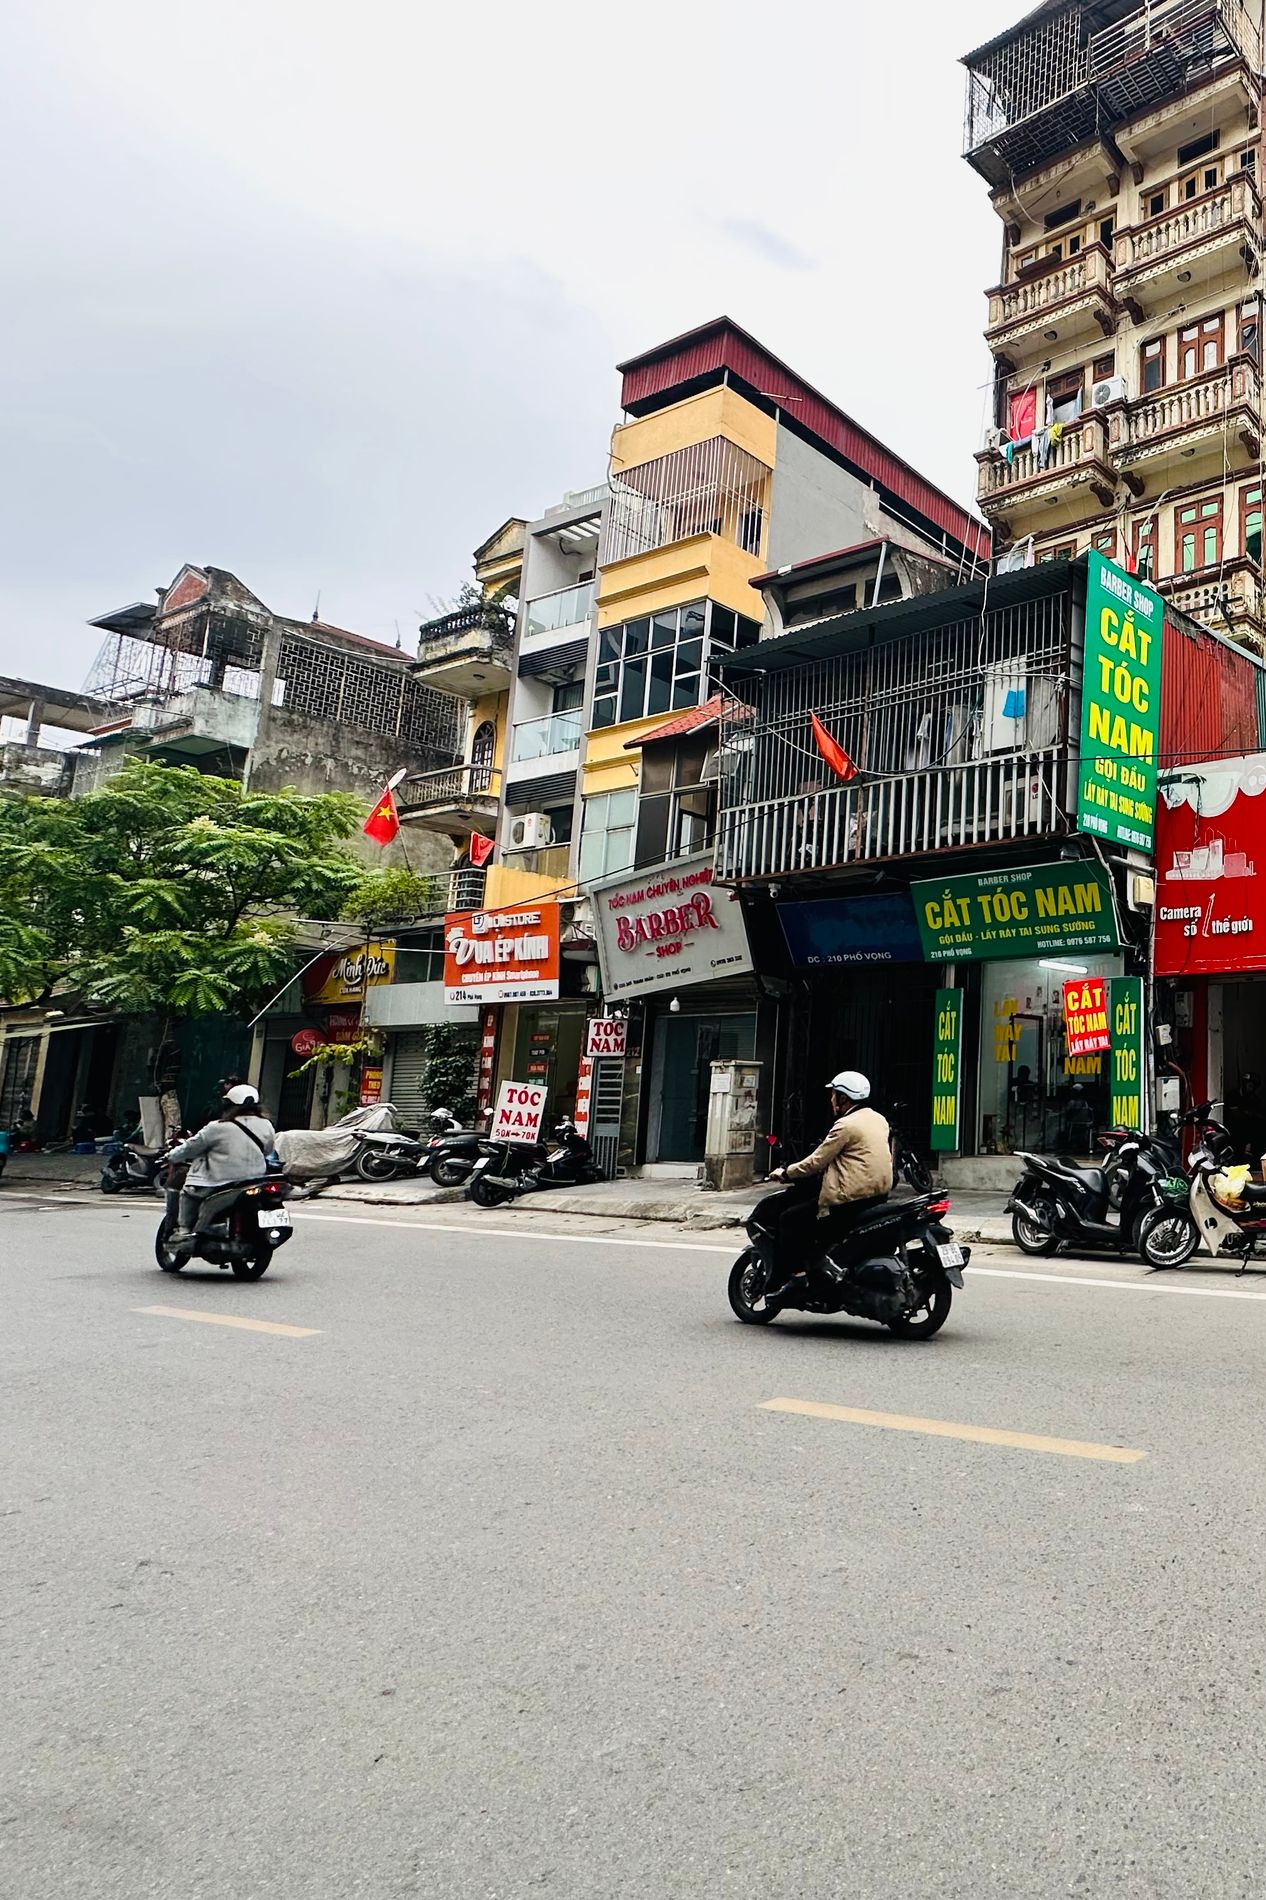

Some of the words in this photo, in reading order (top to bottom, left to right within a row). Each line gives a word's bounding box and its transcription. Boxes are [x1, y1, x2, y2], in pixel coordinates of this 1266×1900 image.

[1100, 566, 1132, 604] BARBER
[1133, 590, 1154, 617] SHOP
[1100, 607, 1152, 667] CẮT
[1098, 653, 1150, 713] TÓC
[1088, 701, 1154, 766] NAM
[977, 874, 1009, 887] BARBER
[1011, 872, 1032, 883] SHOP
[626, 888, 645, 907] NAM
[924, 888, 971, 930] CẮT
[977, 886, 1029, 924] TÓC
[1034, 881, 1102, 918] NAM
[615, 891, 719, 952] BARBER
[1159, 906, 1202, 922] Camera
[1183, 918, 1198, 938] số
[1211, 914, 1231, 935] thế
[1035, 923, 1061, 936] SUNG
[655, 941, 683, 958] SHOP
[1067, 983, 1103, 1011] CẮT
[938, 1000, 957, 1041] CẮT
[1068, 1012, 1086, 1035] TÓC
[1086, 1011, 1108, 1032] NAM
[1115, 991, 1137, 1035] CẮT
[593, 1019, 625, 1037] TÓC
[590, 1038, 626, 1053] NAM
[936, 1047, 955, 1083] TÓC
[1063, 1056, 1102, 1074] NAM
[1114, 1043, 1137, 1081] TÓC
[506, 1085, 542, 1107] TÓC
[498, 1109, 540, 1129] NAM
[933, 1096, 956, 1126] NAM
[1112, 1095, 1139, 1128] NAM
[495, 1128, 512, 1139] 50K
[521, 1130, 537, 1141] 70K
